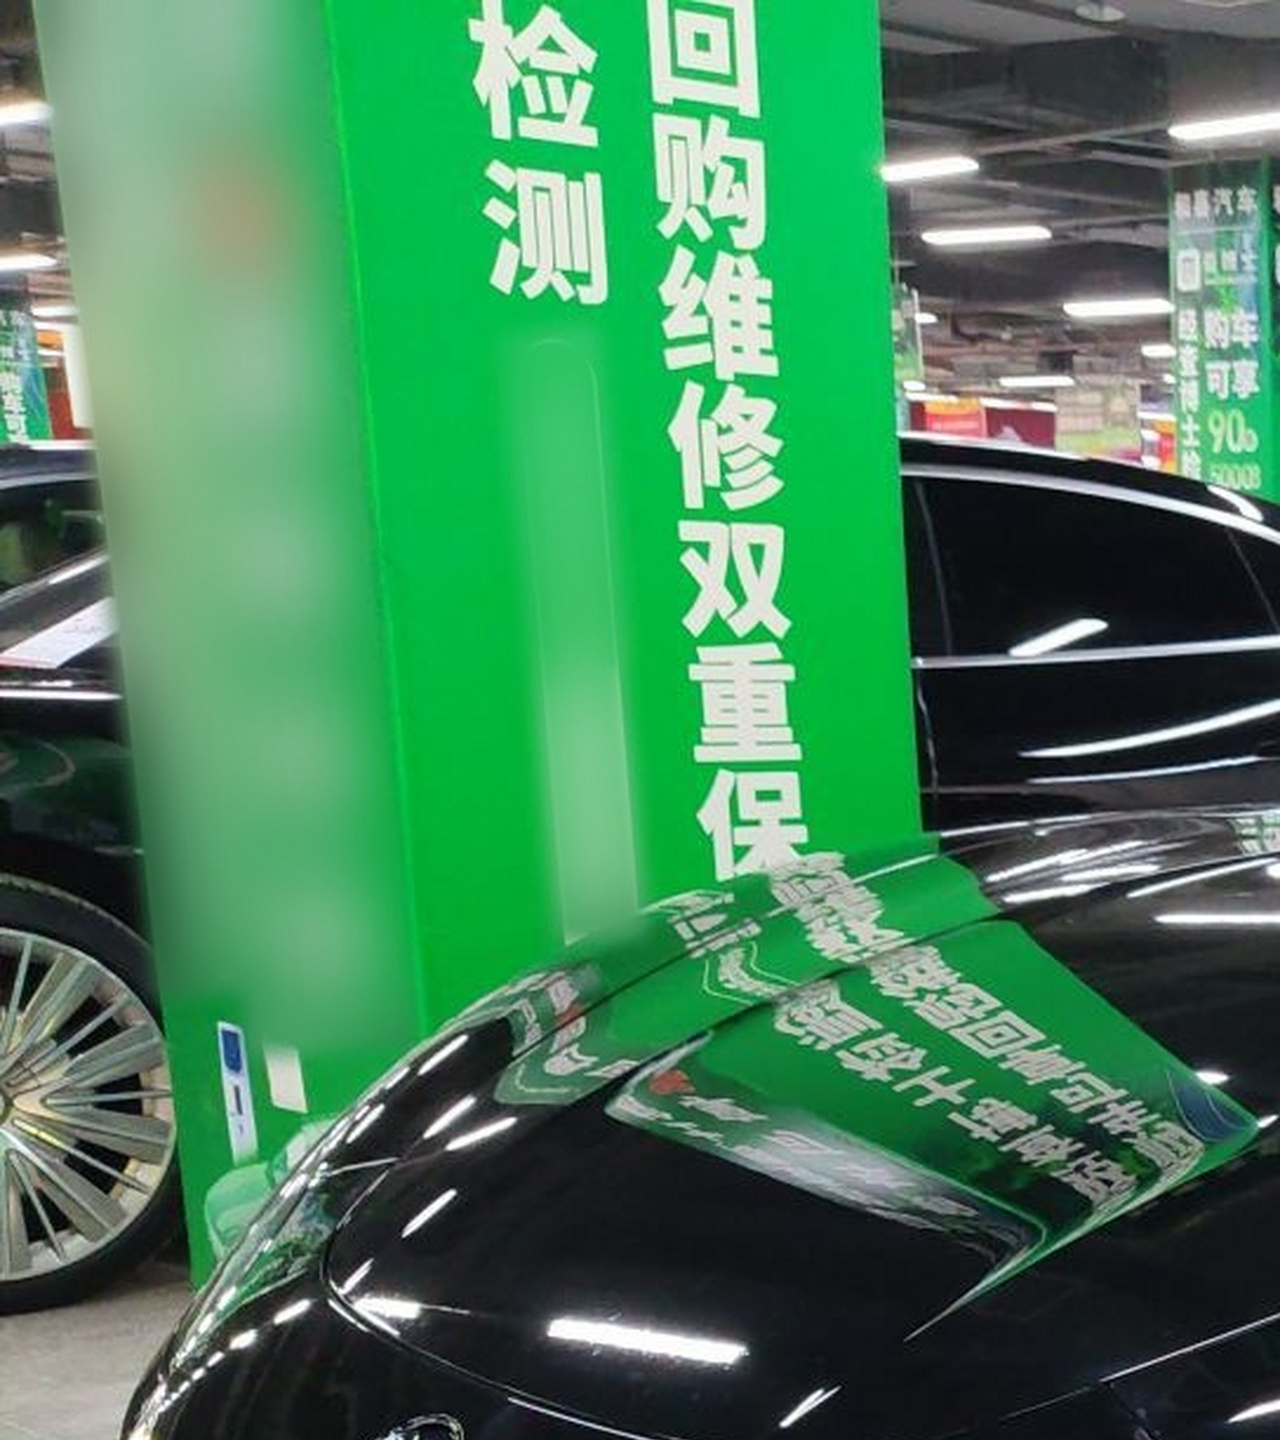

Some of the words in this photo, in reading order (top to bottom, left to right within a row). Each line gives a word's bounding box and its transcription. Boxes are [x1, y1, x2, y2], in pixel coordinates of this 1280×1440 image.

[469, 4, 608, 305] 检测
[646, 0, 810, 881] 回购维修双重保
